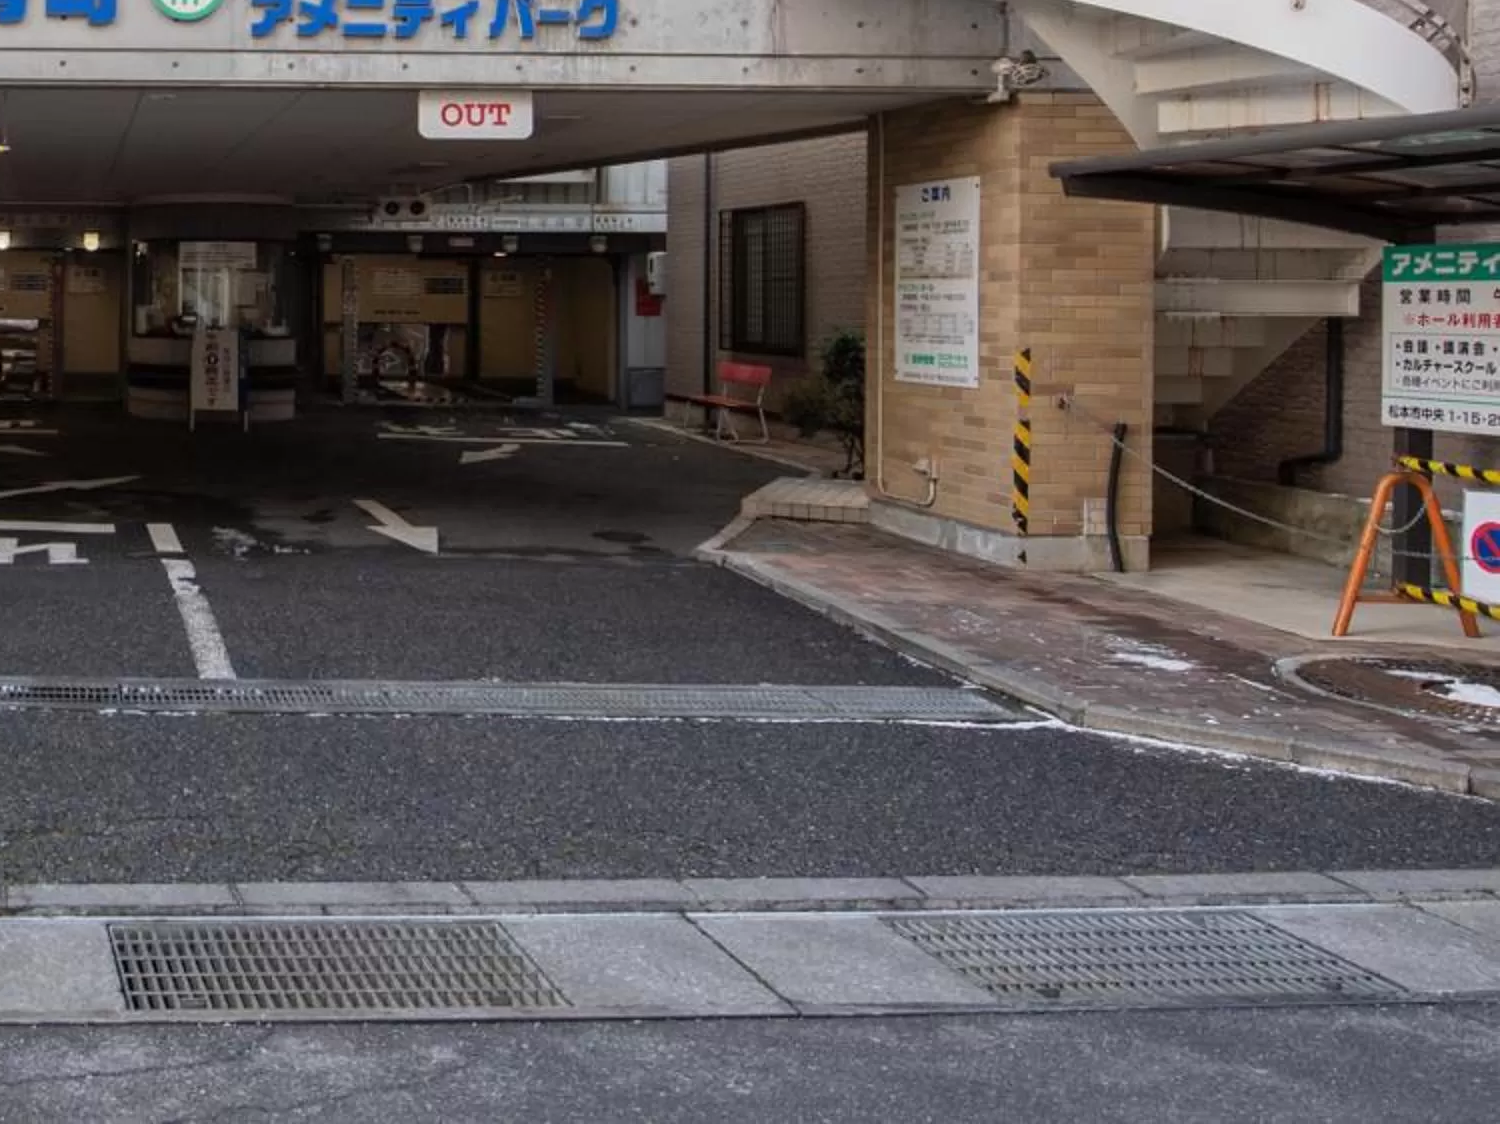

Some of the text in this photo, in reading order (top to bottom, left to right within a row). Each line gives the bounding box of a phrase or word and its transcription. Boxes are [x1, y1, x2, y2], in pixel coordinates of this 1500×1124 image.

[441, 103, 511, 126] OUT
[1400, 287, 1470, 305] 営業時間
